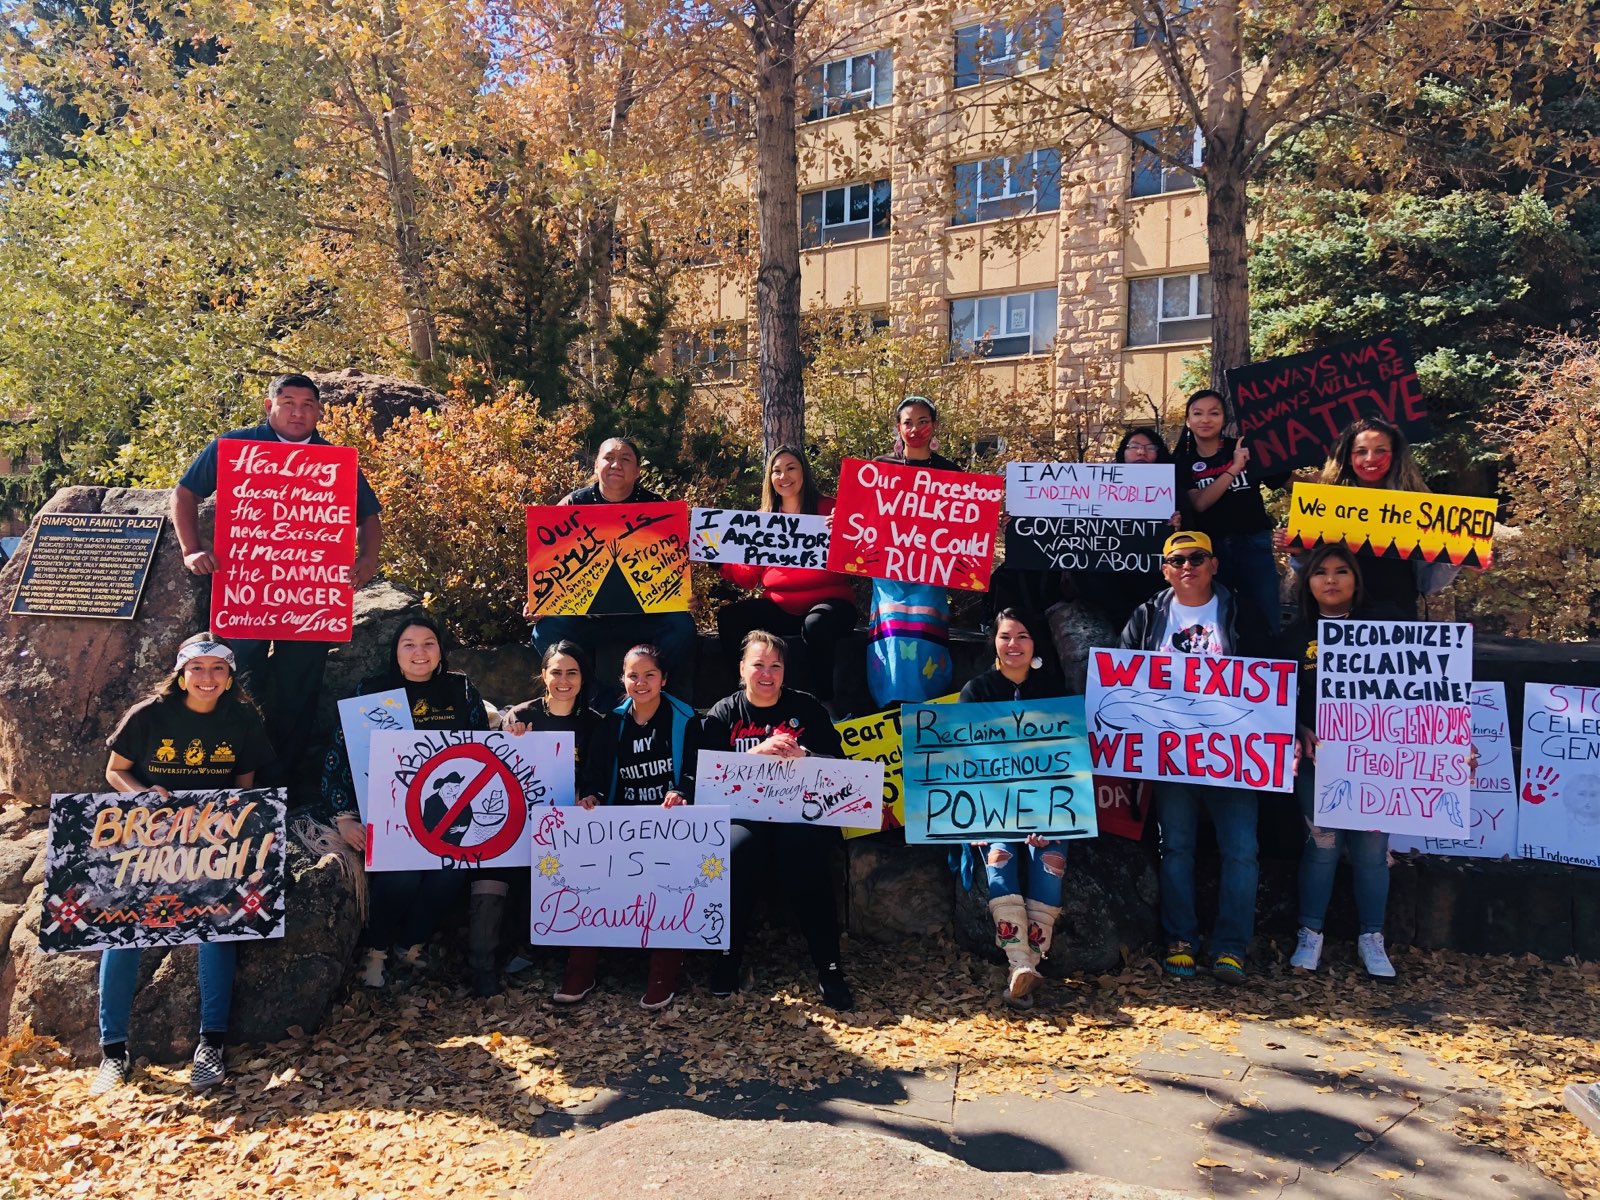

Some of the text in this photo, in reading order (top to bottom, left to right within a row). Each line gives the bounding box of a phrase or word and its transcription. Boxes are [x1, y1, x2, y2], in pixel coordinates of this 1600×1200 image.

[1237, 338, 1396, 407] ALWAYS WAS
[1241, 357, 1405, 436] ALWAYS WILL BE
[857, 463, 1003, 502] Our Ancestors
[1018, 463, 1125, 484] I AM THE
[875, 488, 980, 524] WALKED
[1024, 484, 1173, 503] INDIAN PROBLEM
[42, 516, 158, 528] SIMPSON FAMILY PLAZA
[230, 500, 351, 524] the DAMAGE
[695, 510, 724, 530] I
[1062, 503, 1103, 516] THE
[1298, 496, 1496, 539] We are the SACRED
[537, 510, 580, 545] Our
[842, 513, 990, 558] So We Could
[1014, 517, 1163, 537] GOVERNMENT
[1033, 535, 1121, 553] WARNED
[227, 563, 351, 583] the DAMAGE
[533, 525, 605, 604] Spirit
[884, 546, 957, 586] RUN
[1046, 552, 1164, 573] YOU ABOUT
[223, 583, 347, 607] NO LONGER
[1323, 622, 1468, 648] DECOLONIZE!
[1095, 652, 1296, 706] WE EXIST
[1322, 650, 1450, 681] RECLAIM!
[1321, 677, 1472, 705] REIMAGINE!
[1010, 709, 1072, 738] Your
[1318, 702, 1472, 746] INDIGENOUS
[395, 730, 474, 788] ABOLISH
[633, 737, 652, 753] MY
[1088, 730, 1294, 788] WE RESIST
[148, 765, 192, 775] UNIVERSITY
[198, 767, 233, 775] WYOMIN
[620, 758, 673, 779] CULTURE
[722, 760, 796, 783] BREAKING
[913, 751, 1072, 783] INDIGENOUS
[1347, 744, 1468, 785] PEOPLES
[639, 785, 664, 801] NOT
[1360, 782, 1443, 817] DAY
[926, 785, 1077, 833] POWER
[549, 818, 726, 851] INDIGENOUS
[1425, 835, 1485, 850] HERE!
[110, 832, 276, 889] THROUGH!
[534, 887, 707, 948] Beautiful
